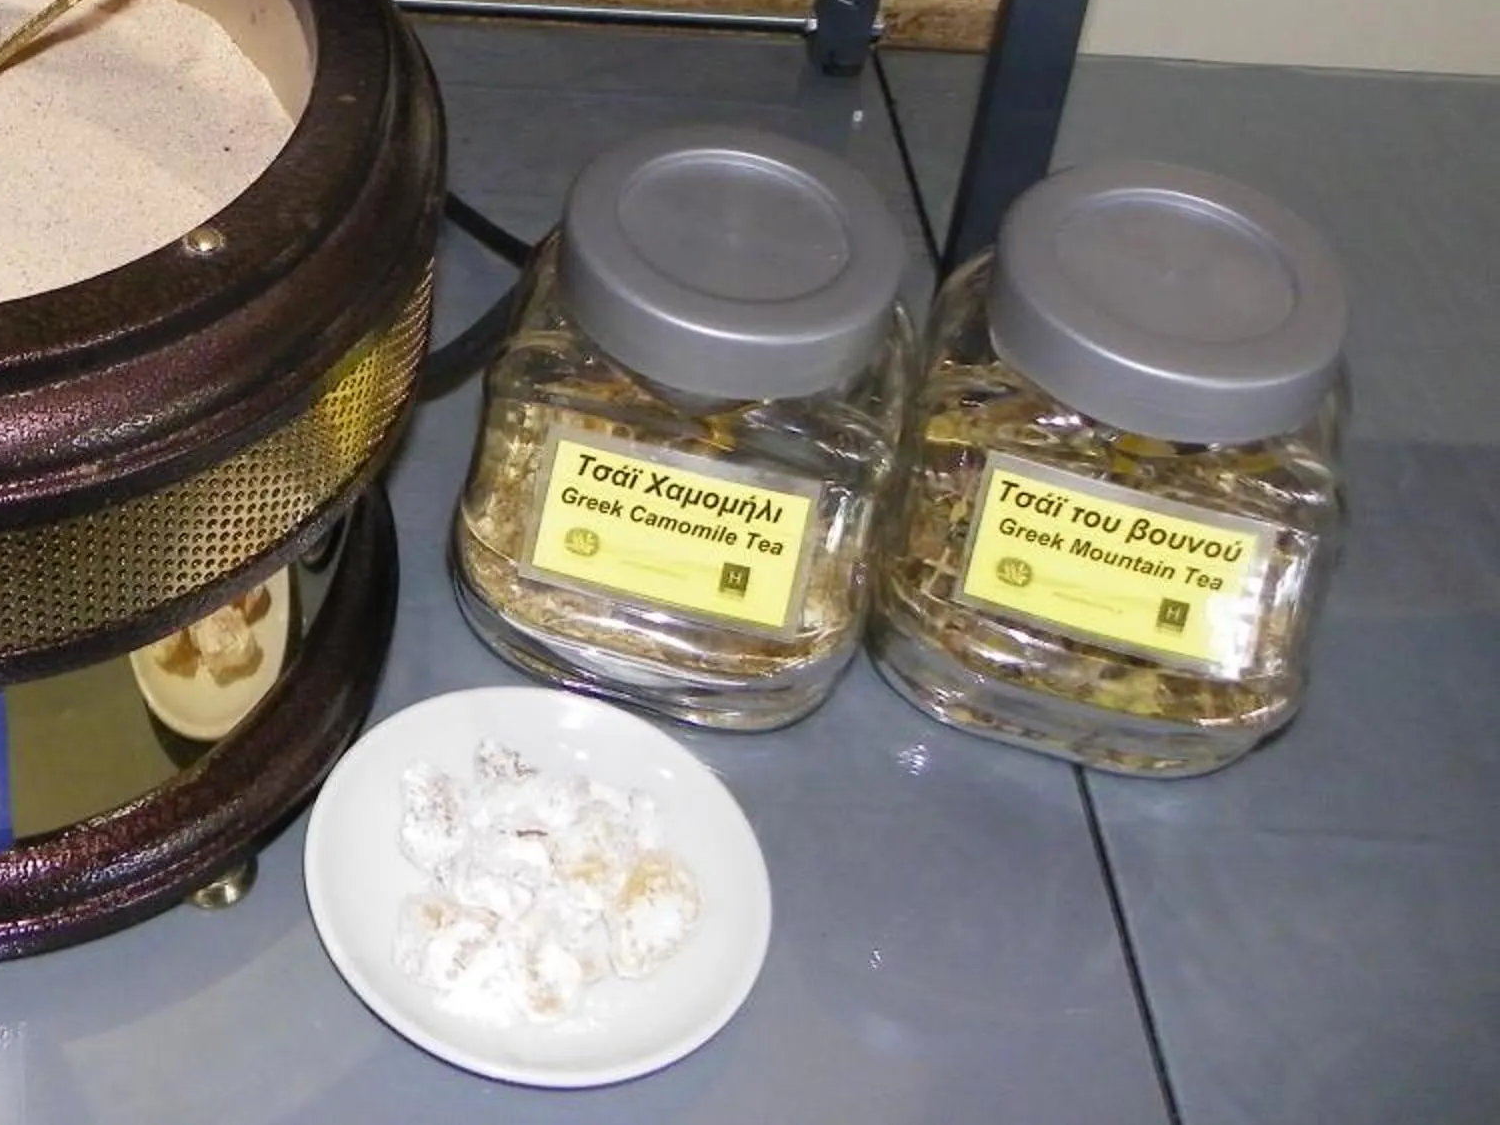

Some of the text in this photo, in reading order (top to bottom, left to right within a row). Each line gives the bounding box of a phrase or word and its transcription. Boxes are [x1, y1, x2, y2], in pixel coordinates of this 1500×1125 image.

[561, 486, 785, 557] Greek Camomile Tea
[644, 473, 783, 525] Χαμομήλι
[997, 517, 1225, 592] Greek Mountain Tea
[1070, 506, 1122, 534] του
[1124, 518, 1244, 563] βουνού
